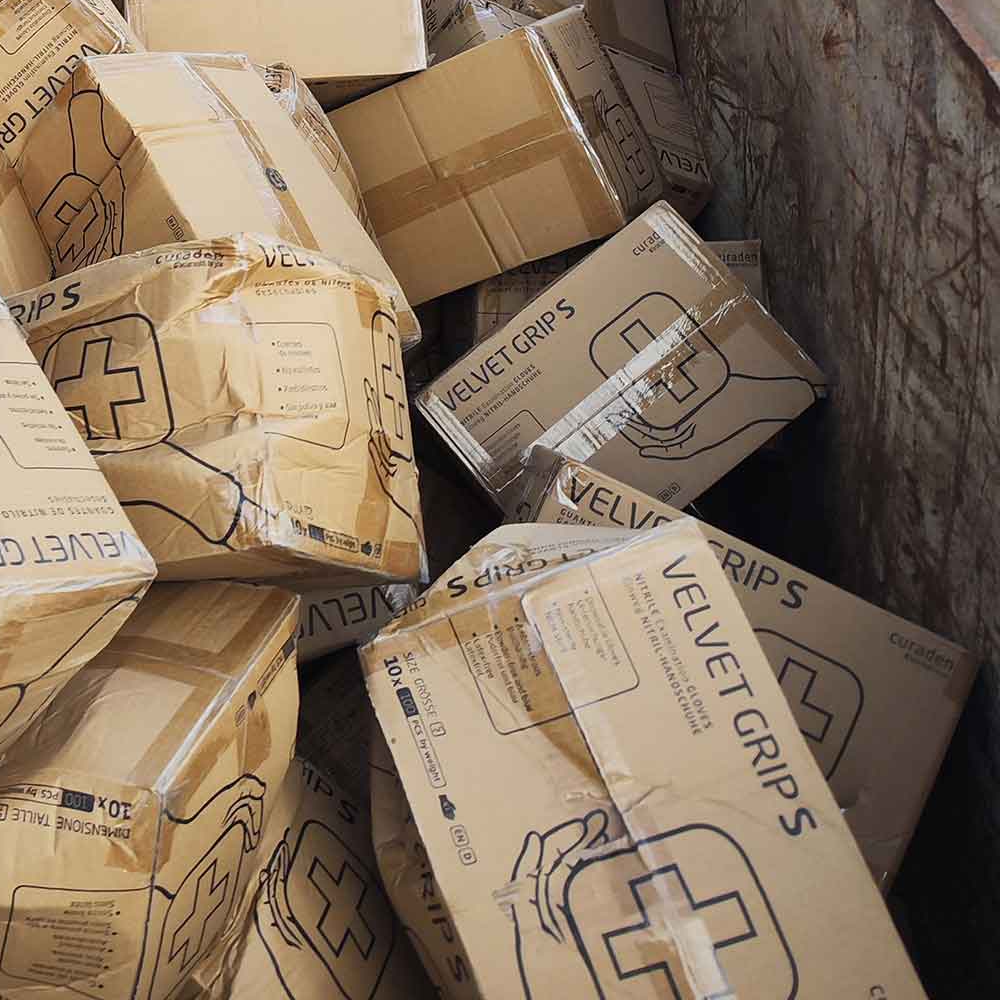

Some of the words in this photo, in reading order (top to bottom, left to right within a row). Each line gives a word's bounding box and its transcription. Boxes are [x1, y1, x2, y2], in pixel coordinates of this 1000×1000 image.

[32, 43, 100, 119] VELVET
[263, 243, 318, 268] VEL
[632, 231, 662, 256] curad
[716, 250, 758, 263] uraden
[10, 281, 81, 326] RIPS
[439, 345, 513, 412] VELVET
[511, 298, 576, 354] GRIPS
[559, 507, 596, 528] GUANT
[569, 475, 672, 530] VELV
[31, 531, 146, 564] VELVET
[447, 558, 548, 598] GRIPS
[300, 585, 398, 637] VELV
[402, 651, 420, 674] SIZE
[888, 630, 954, 674] curaden
[662, 554, 754, 697] VELVET
[733, 708, 817, 837] GRIPS
[685, 683, 713, 730] GLOVES
[383, 655, 404, 688] 10x
[411, 718, 425, 738] PCS
[424, 750, 442, 782] weight
[41, 790, 59, 801] PCS
[98, 795, 132, 820] 10x
[11, 807, 51, 828] TAILLE
[56, 815, 131, 839] DIMENSIONE
